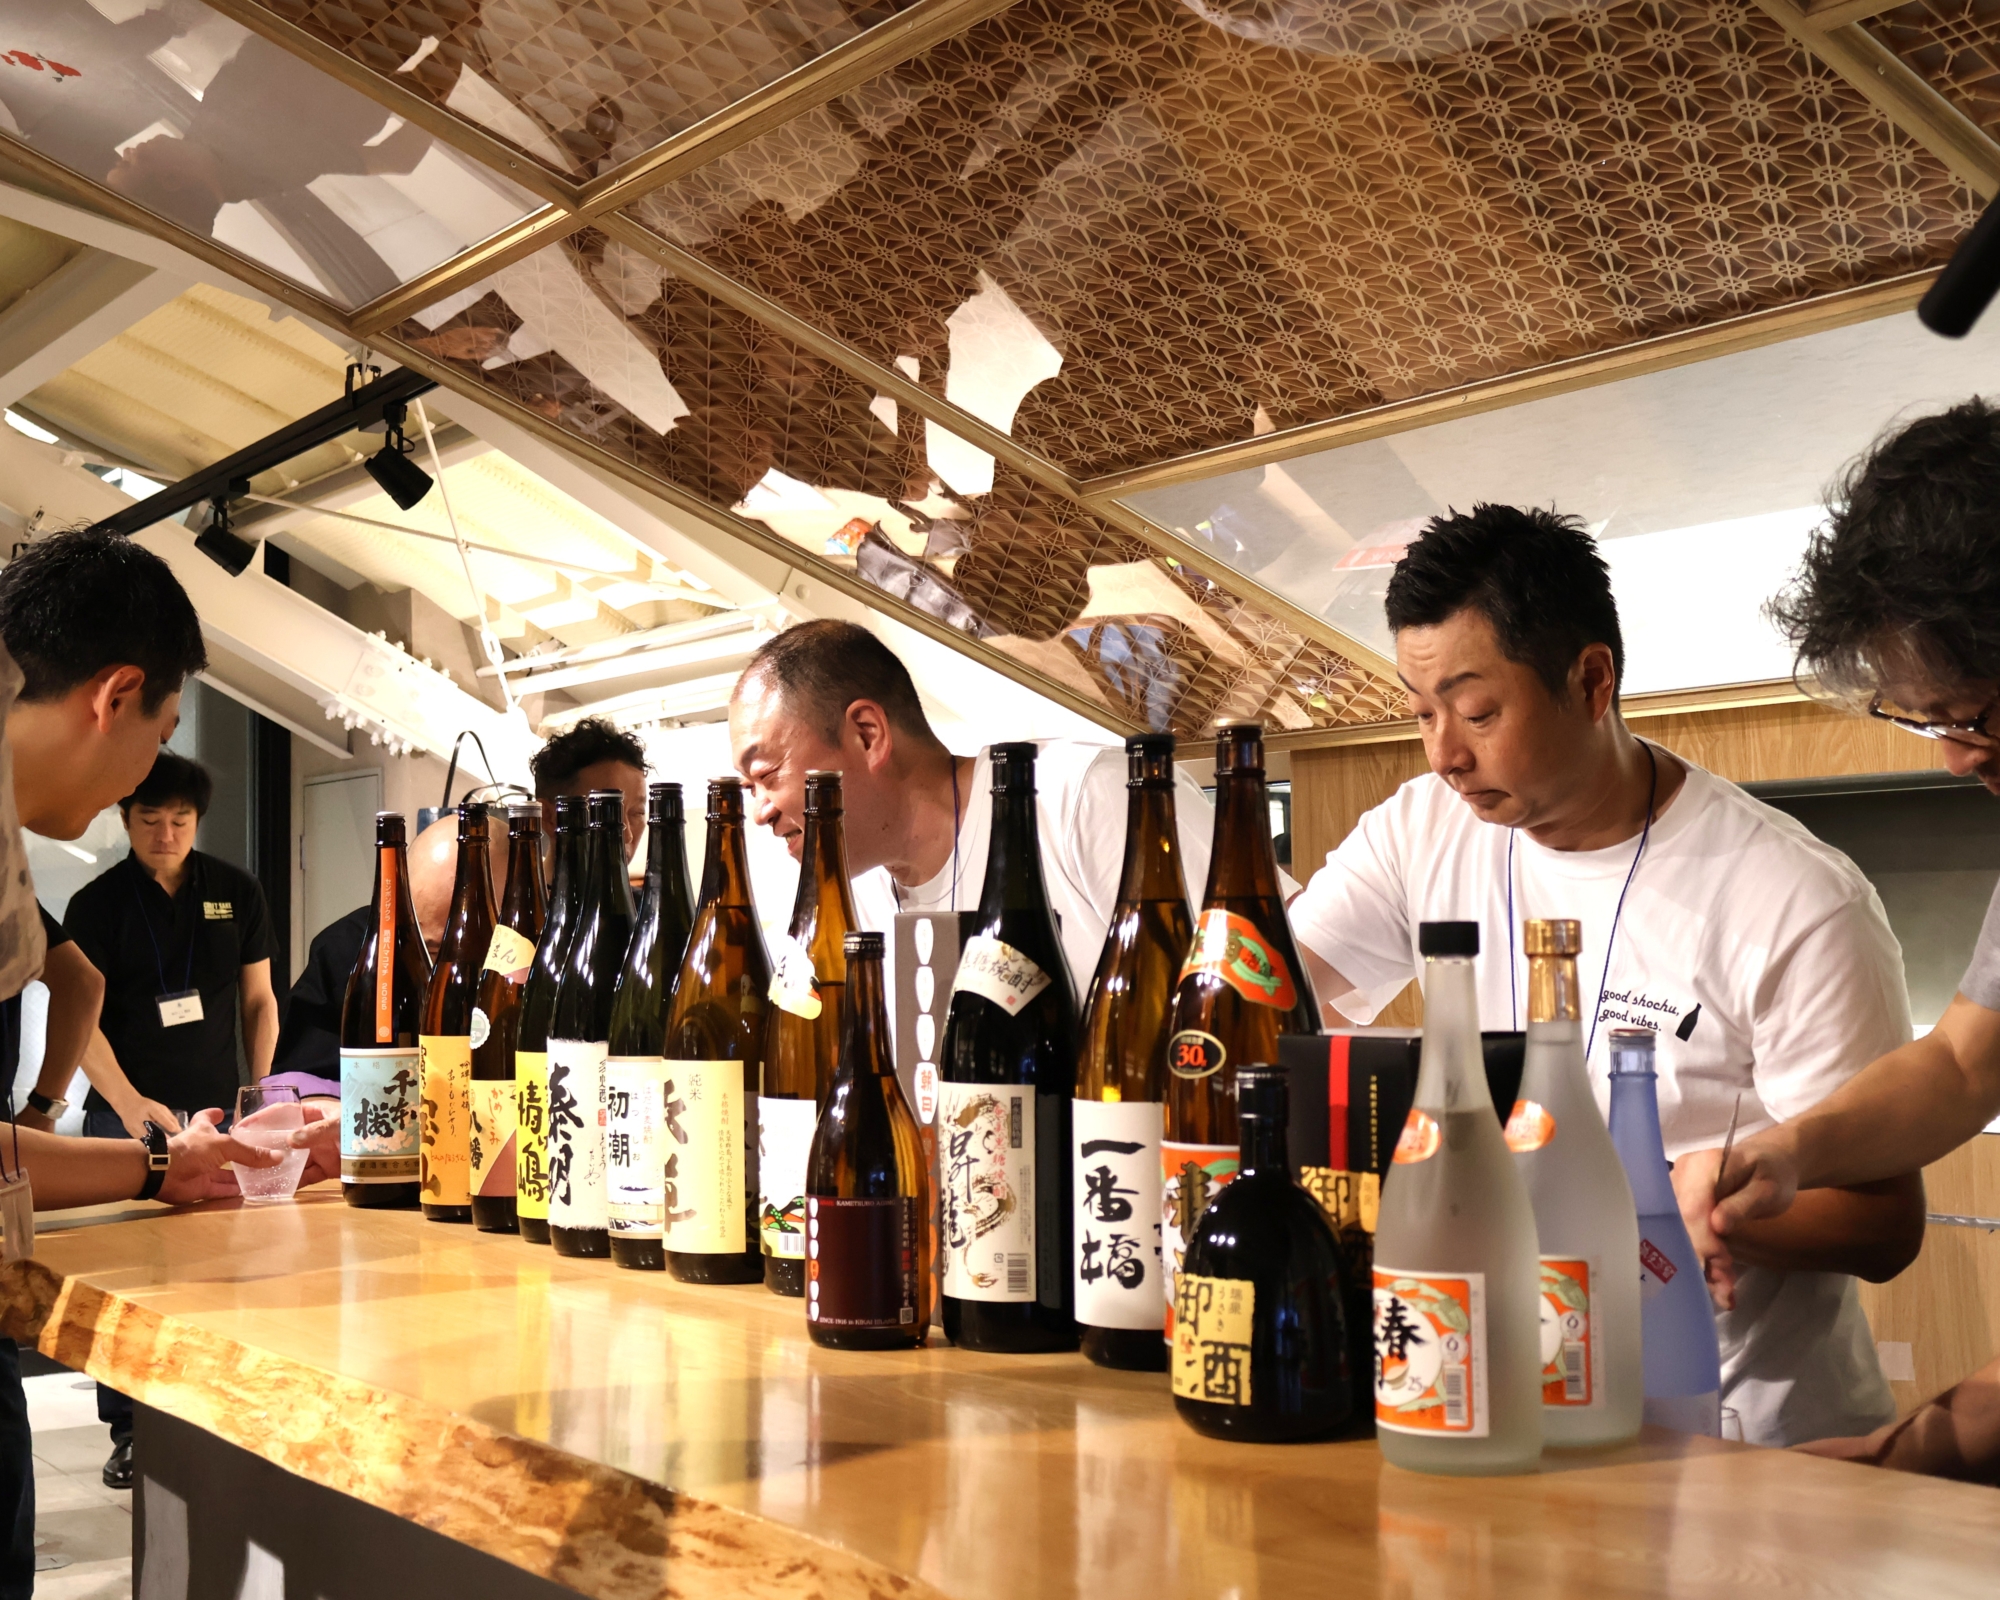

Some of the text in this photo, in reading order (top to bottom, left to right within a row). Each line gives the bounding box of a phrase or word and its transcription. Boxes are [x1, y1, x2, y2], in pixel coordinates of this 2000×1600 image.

[1598, 1008, 1662, 1032] good vibes.
[1601, 989, 1680, 1017] good shochu,
[688, 1073, 703, 1101] 純米
[920, 1069, 933, 1113] 朝日
[607, 1086, 631, 1168] 初潮
[1080, 1139, 1146, 1290] 一番橋
